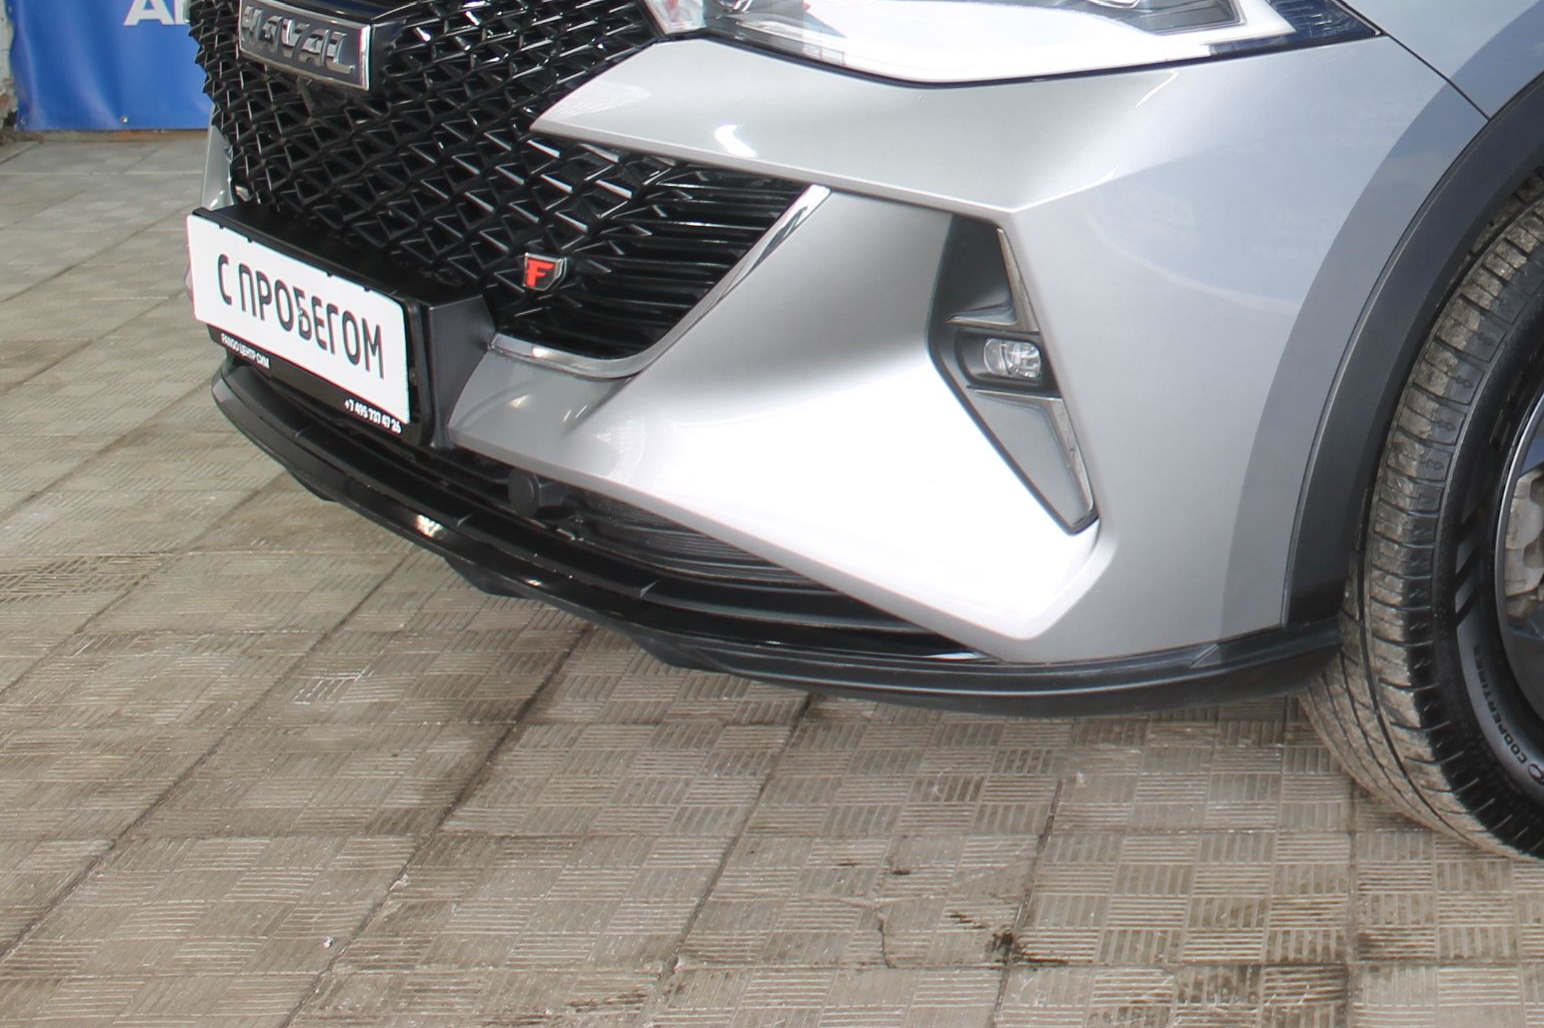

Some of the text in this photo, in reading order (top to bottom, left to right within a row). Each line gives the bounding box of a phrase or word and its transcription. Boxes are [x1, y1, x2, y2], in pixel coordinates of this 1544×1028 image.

[241, 5, 355, 75] HAVAL
[526, 258, 556, 288] F
[217, 253, 385, 380] С ПРОБЕГОМ
